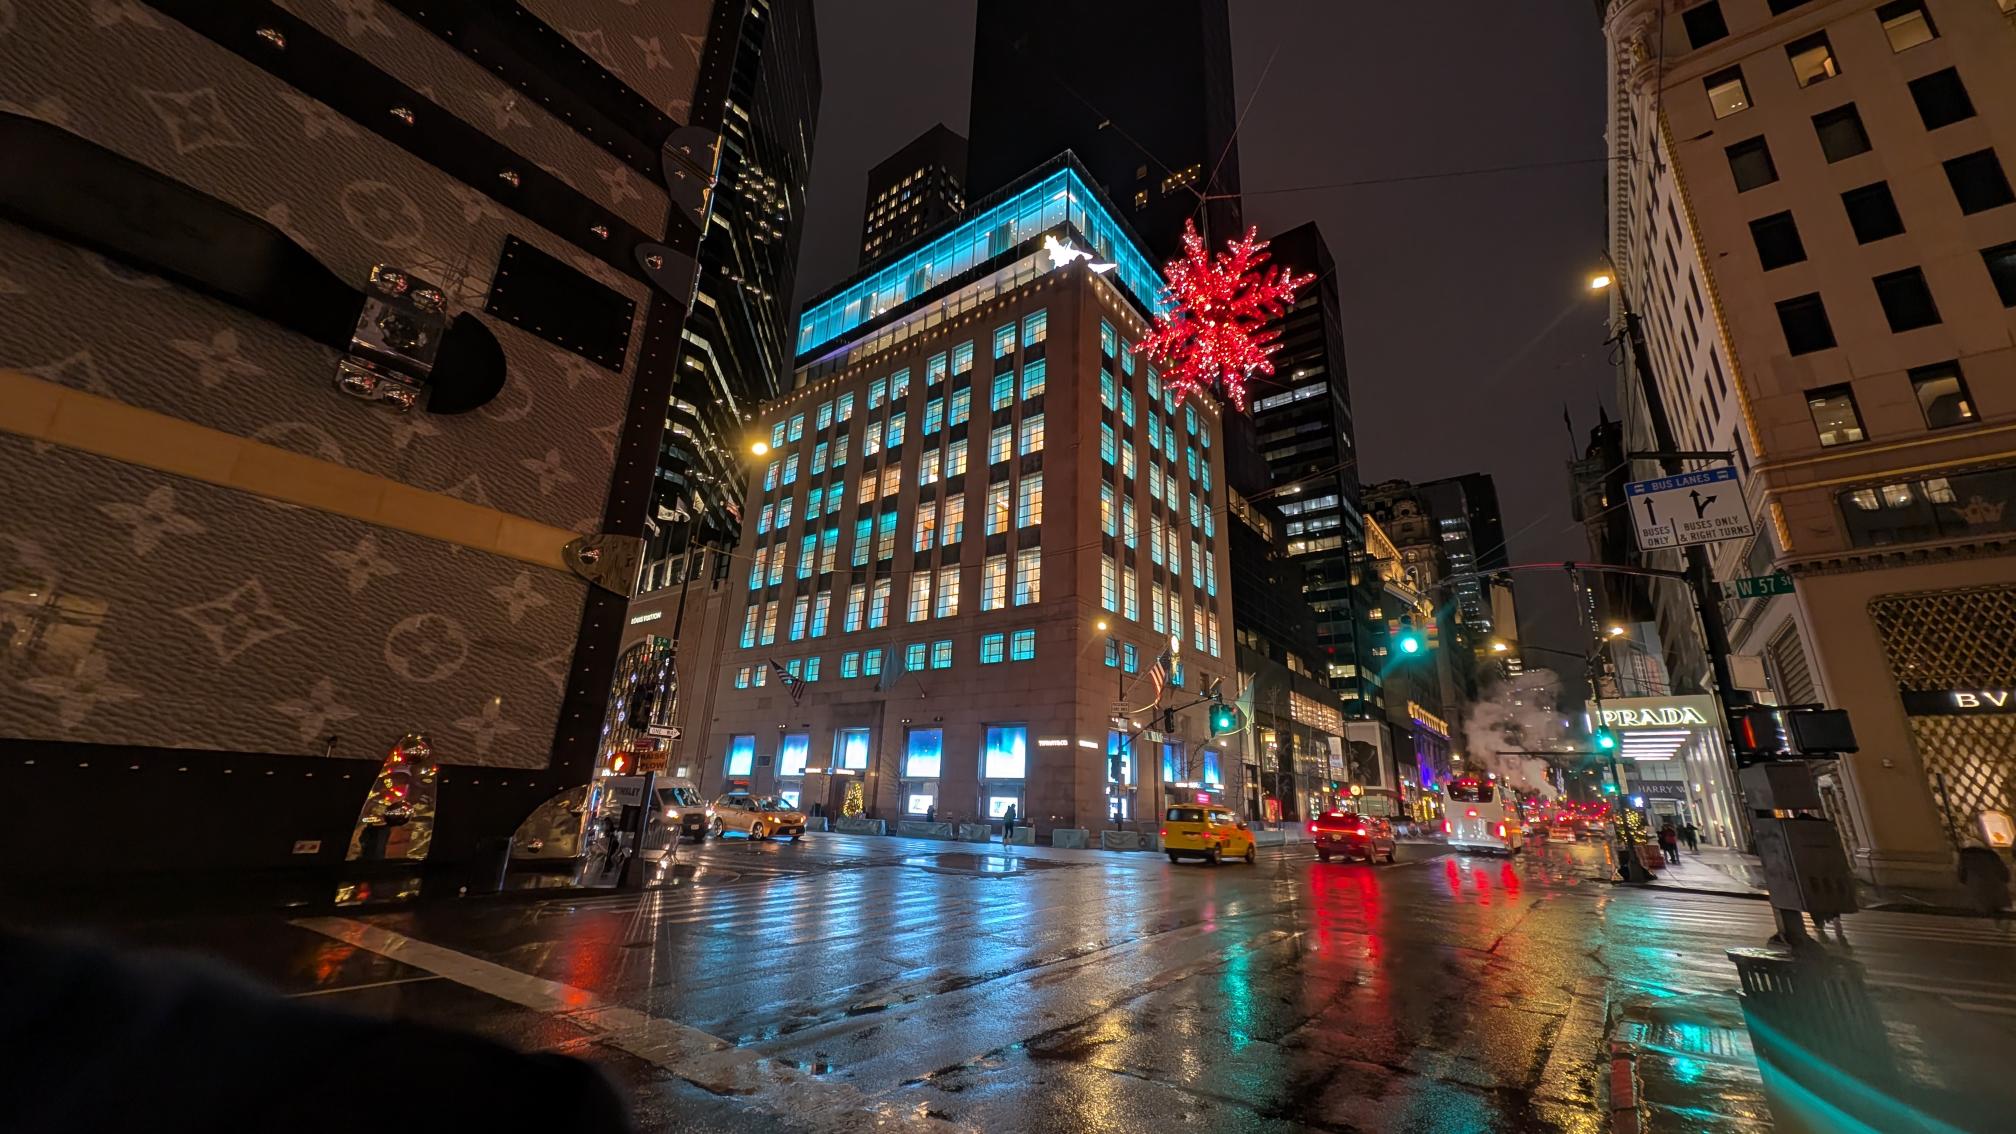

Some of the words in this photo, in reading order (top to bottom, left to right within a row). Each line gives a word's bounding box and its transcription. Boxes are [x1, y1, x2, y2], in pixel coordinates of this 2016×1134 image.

[1652, 479, 1673, 491] BUS
[1676, 473, 1711, 486] LANES
[1643, 526, 1670, 537] BUSES
[1684, 521, 1712, 531] BUSES
[1715, 516, 1738, 527] ONLY
[1648, 537, 1669, 546] ONLY
[1680, 534, 1688, 542] &
[1691, 530, 1717, 541] RIGHT
[1719, 525, 1750, 537] TURNS
[1739, 580, 1752, 595] W
[1759, 578, 1775, 593] 57
[1596, 707, 1707, 727] PRADA
[1638, 785, 1673, 794] HARRY
